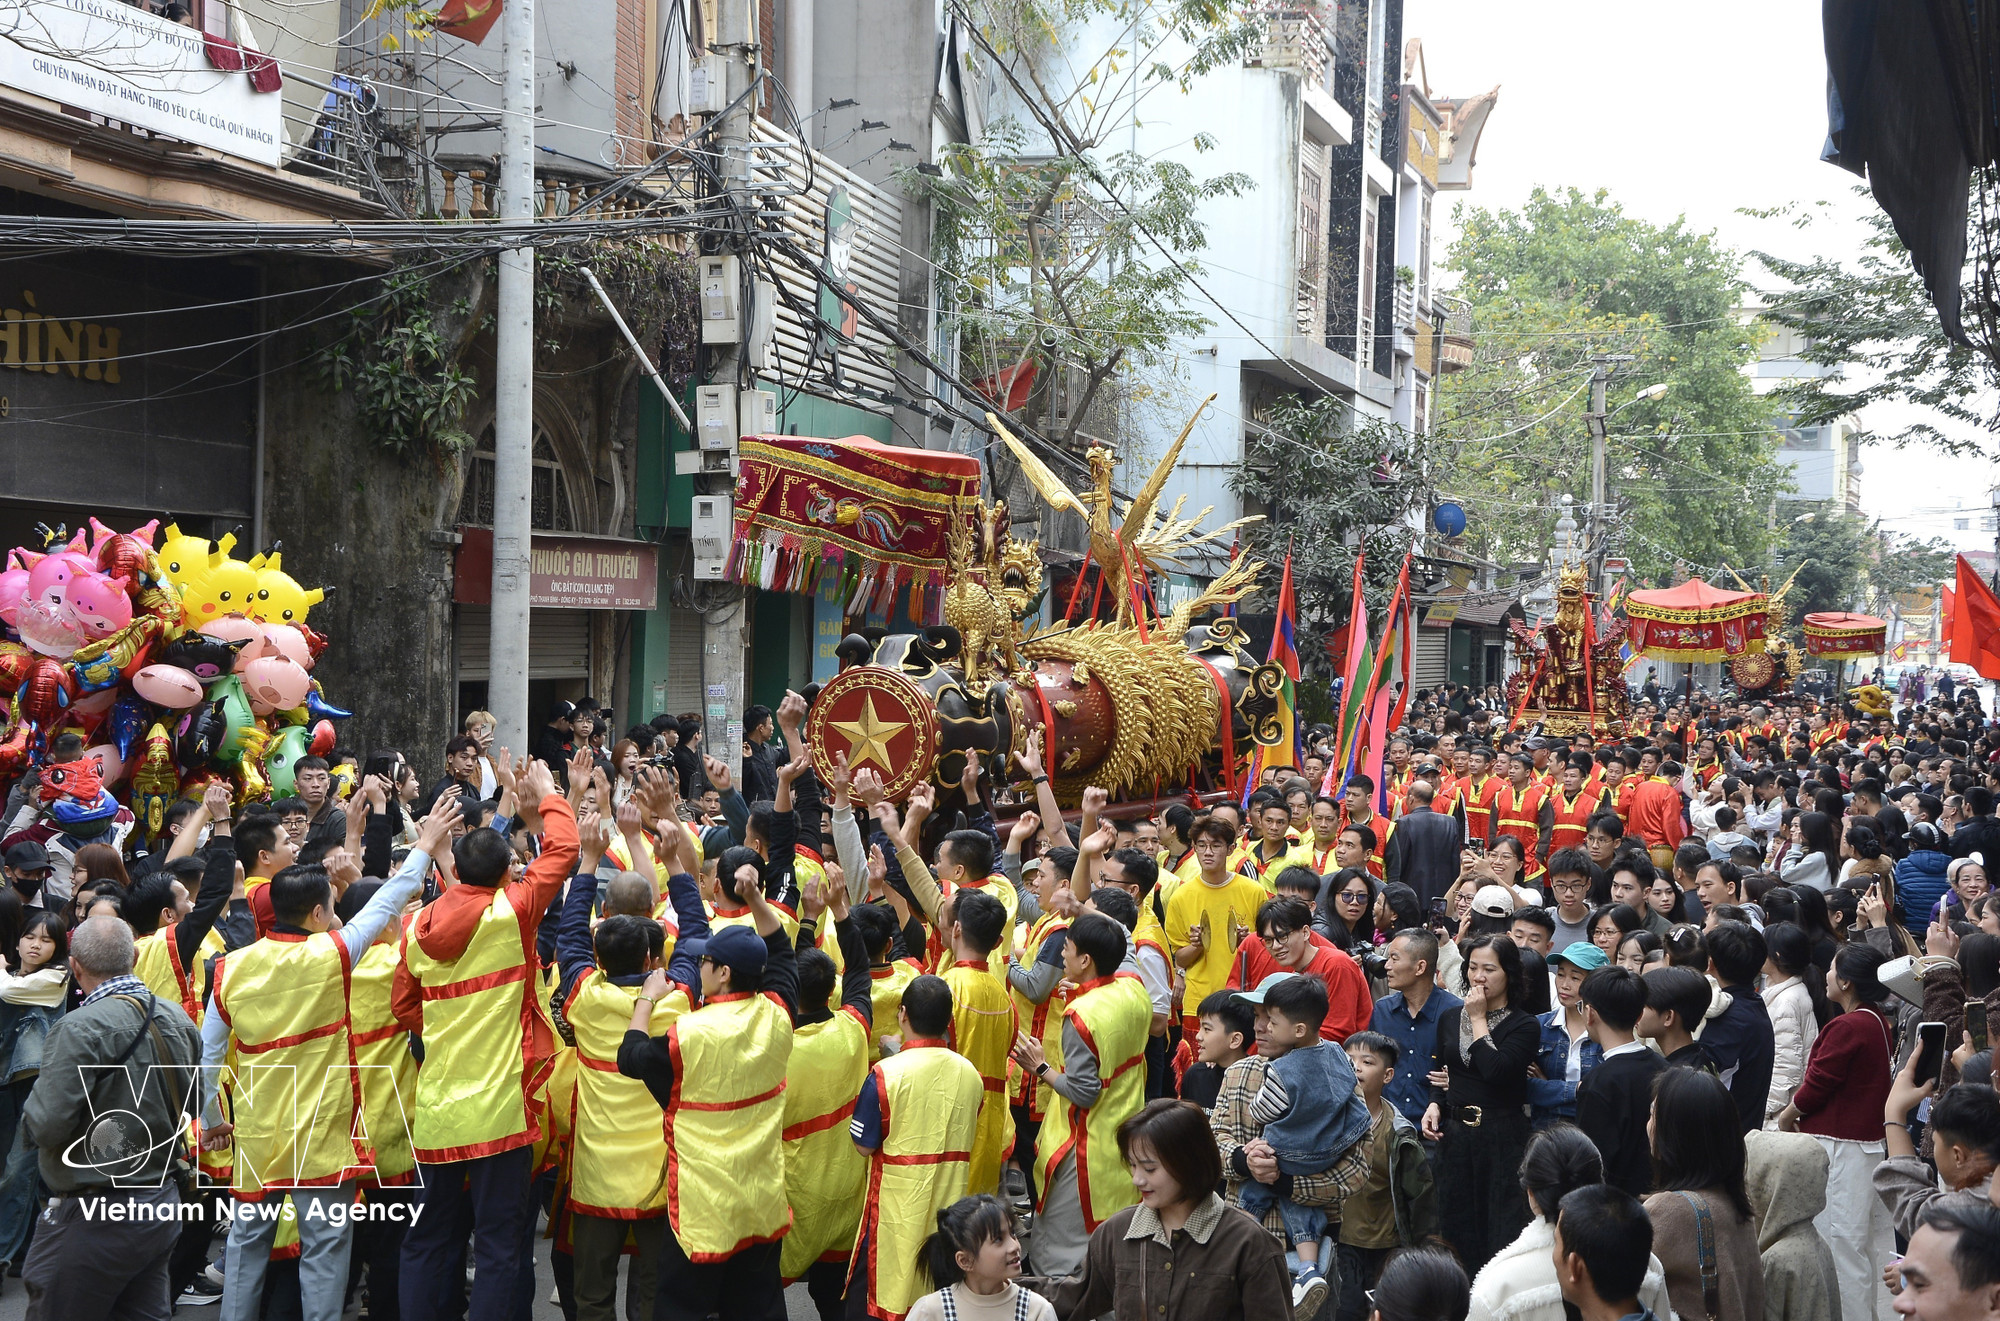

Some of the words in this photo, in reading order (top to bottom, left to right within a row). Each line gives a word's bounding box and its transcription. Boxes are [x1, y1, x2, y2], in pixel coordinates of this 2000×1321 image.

[33, 58, 69, 81] CHUYÊN
[71, 71, 97, 90] NHẬN
[98, 80, 118, 97] ĐẶT
[120, 87, 146, 105] HÀNG
[147, 95, 170, 113] THEO
[171, 103, 188, 119] YÊU
[189, 108, 208, 125] CẦU
[209, 113, 226, 131] CỦA
[227, 122, 245, 137] QUÝ
[245, 128, 273, 145] KHÁCH
[530, 544, 571, 576] THUỐC
[573, 551, 593, 577] GIA
[596, 549, 639, 579] TRUYỀN
[819, 617, 843, 636] BÀN
